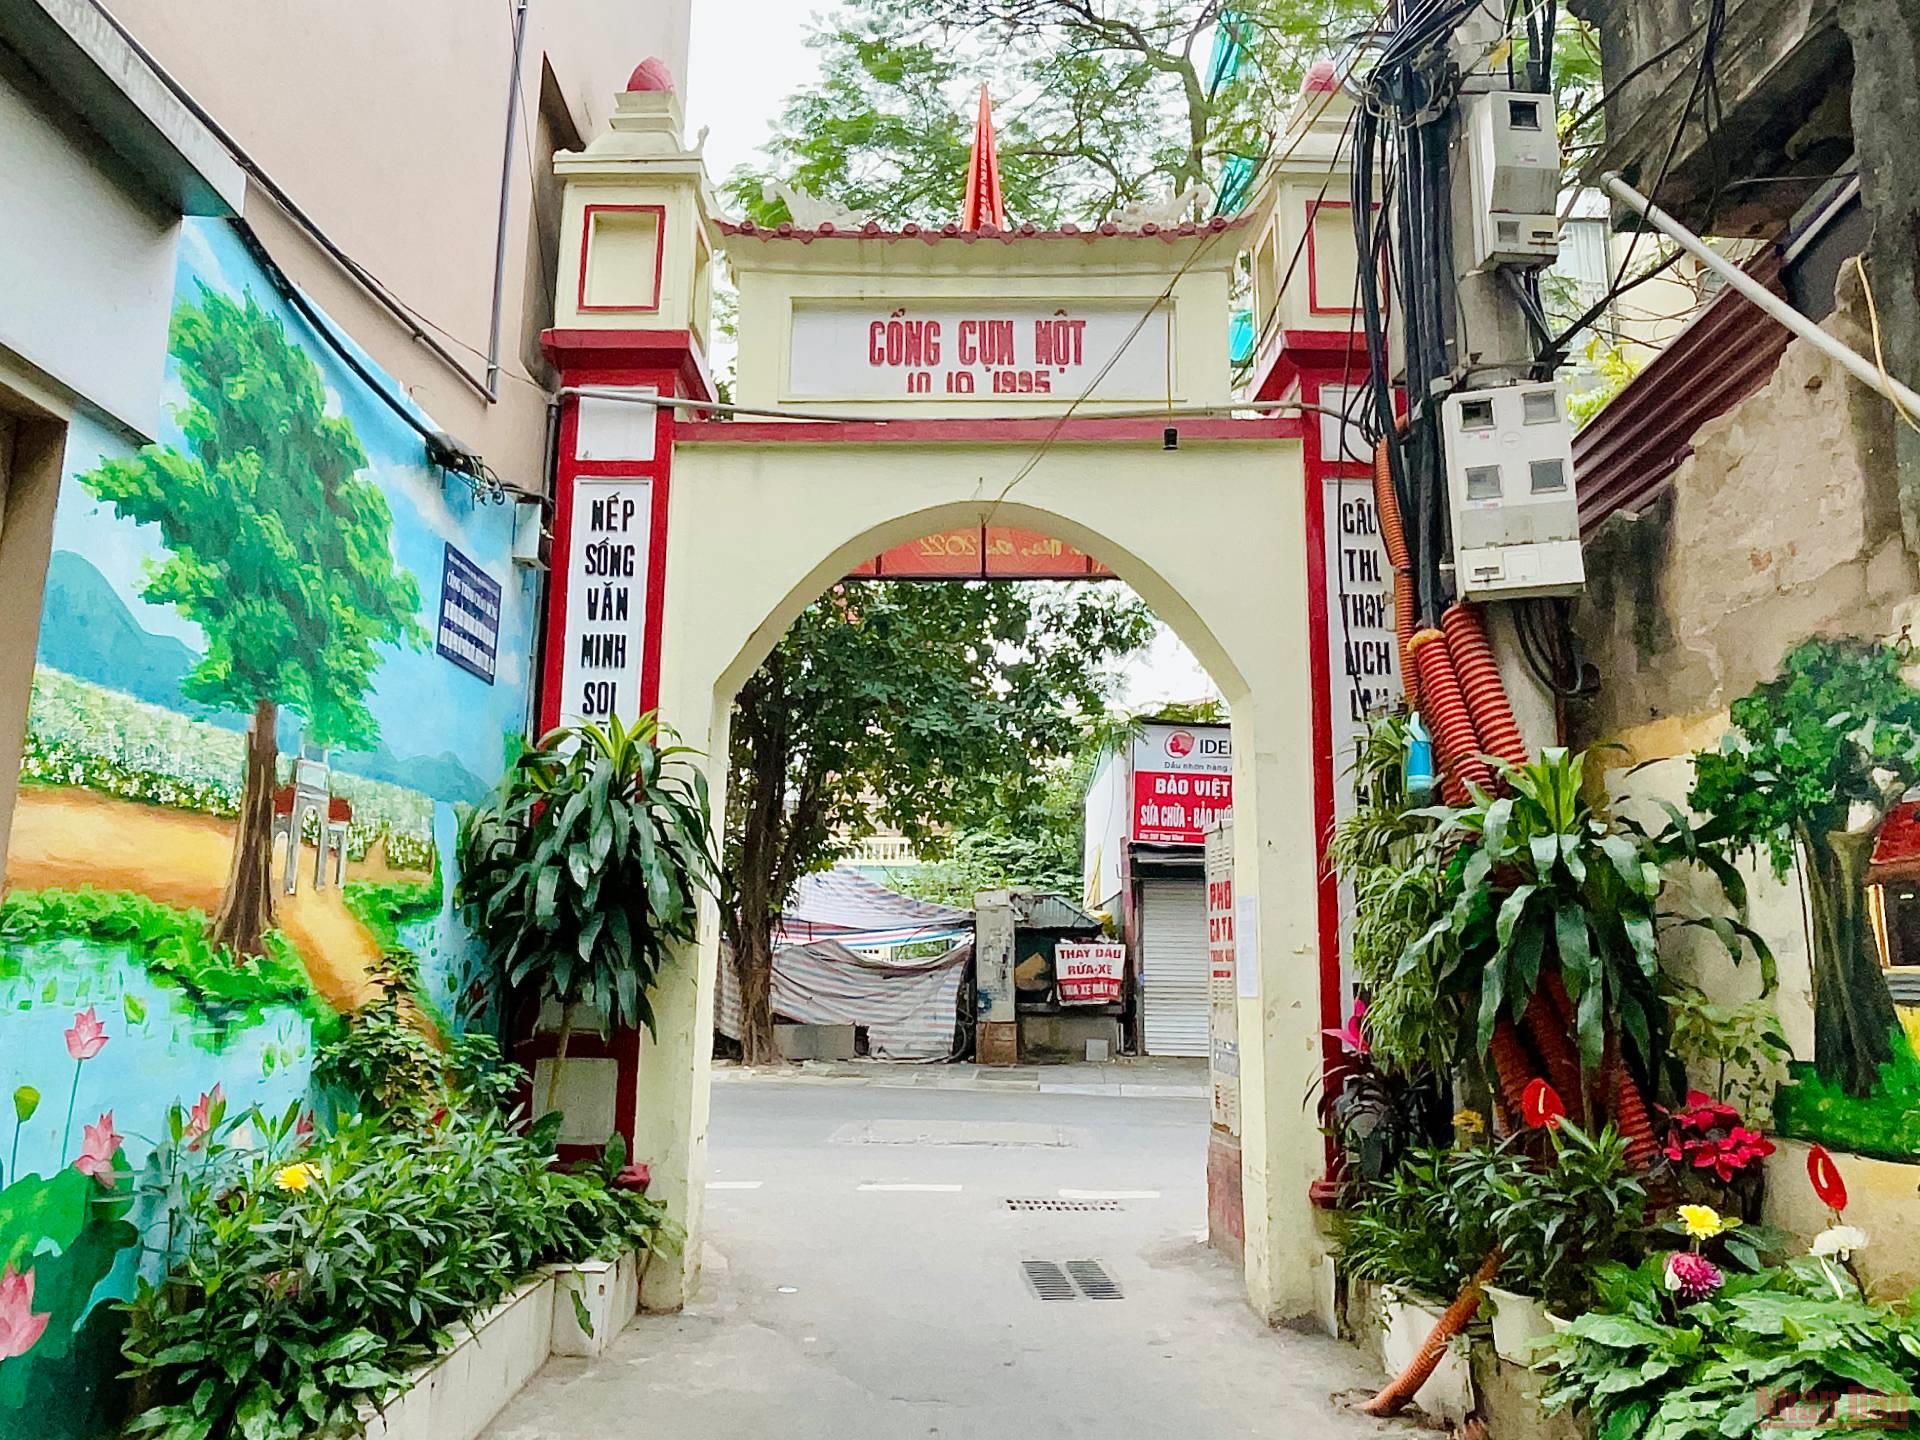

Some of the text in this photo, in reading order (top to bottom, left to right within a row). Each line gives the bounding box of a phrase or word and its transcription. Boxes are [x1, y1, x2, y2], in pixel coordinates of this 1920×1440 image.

[869, 308, 1086, 373] CỔNG CỤM MỘT
[946, 371, 974, 394] 10
[993, 370, 1051, 394] 1995
[591, 491, 635, 532] NẾP
[585, 537, 635, 578] SỐNG
[587, 581, 628, 621] VĂN
[581, 634, 627, 669] MINH
[582, 681, 616, 715] SOI
[1200, 739, 1232, 755] IDE
[1155, 774, 1231, 800] BẢO VIỆT
[1140, 798, 1159, 826] SỬA
[1161, 802, 1185, 828] CHỮA
[1060, 949, 1090, 960] THAY
